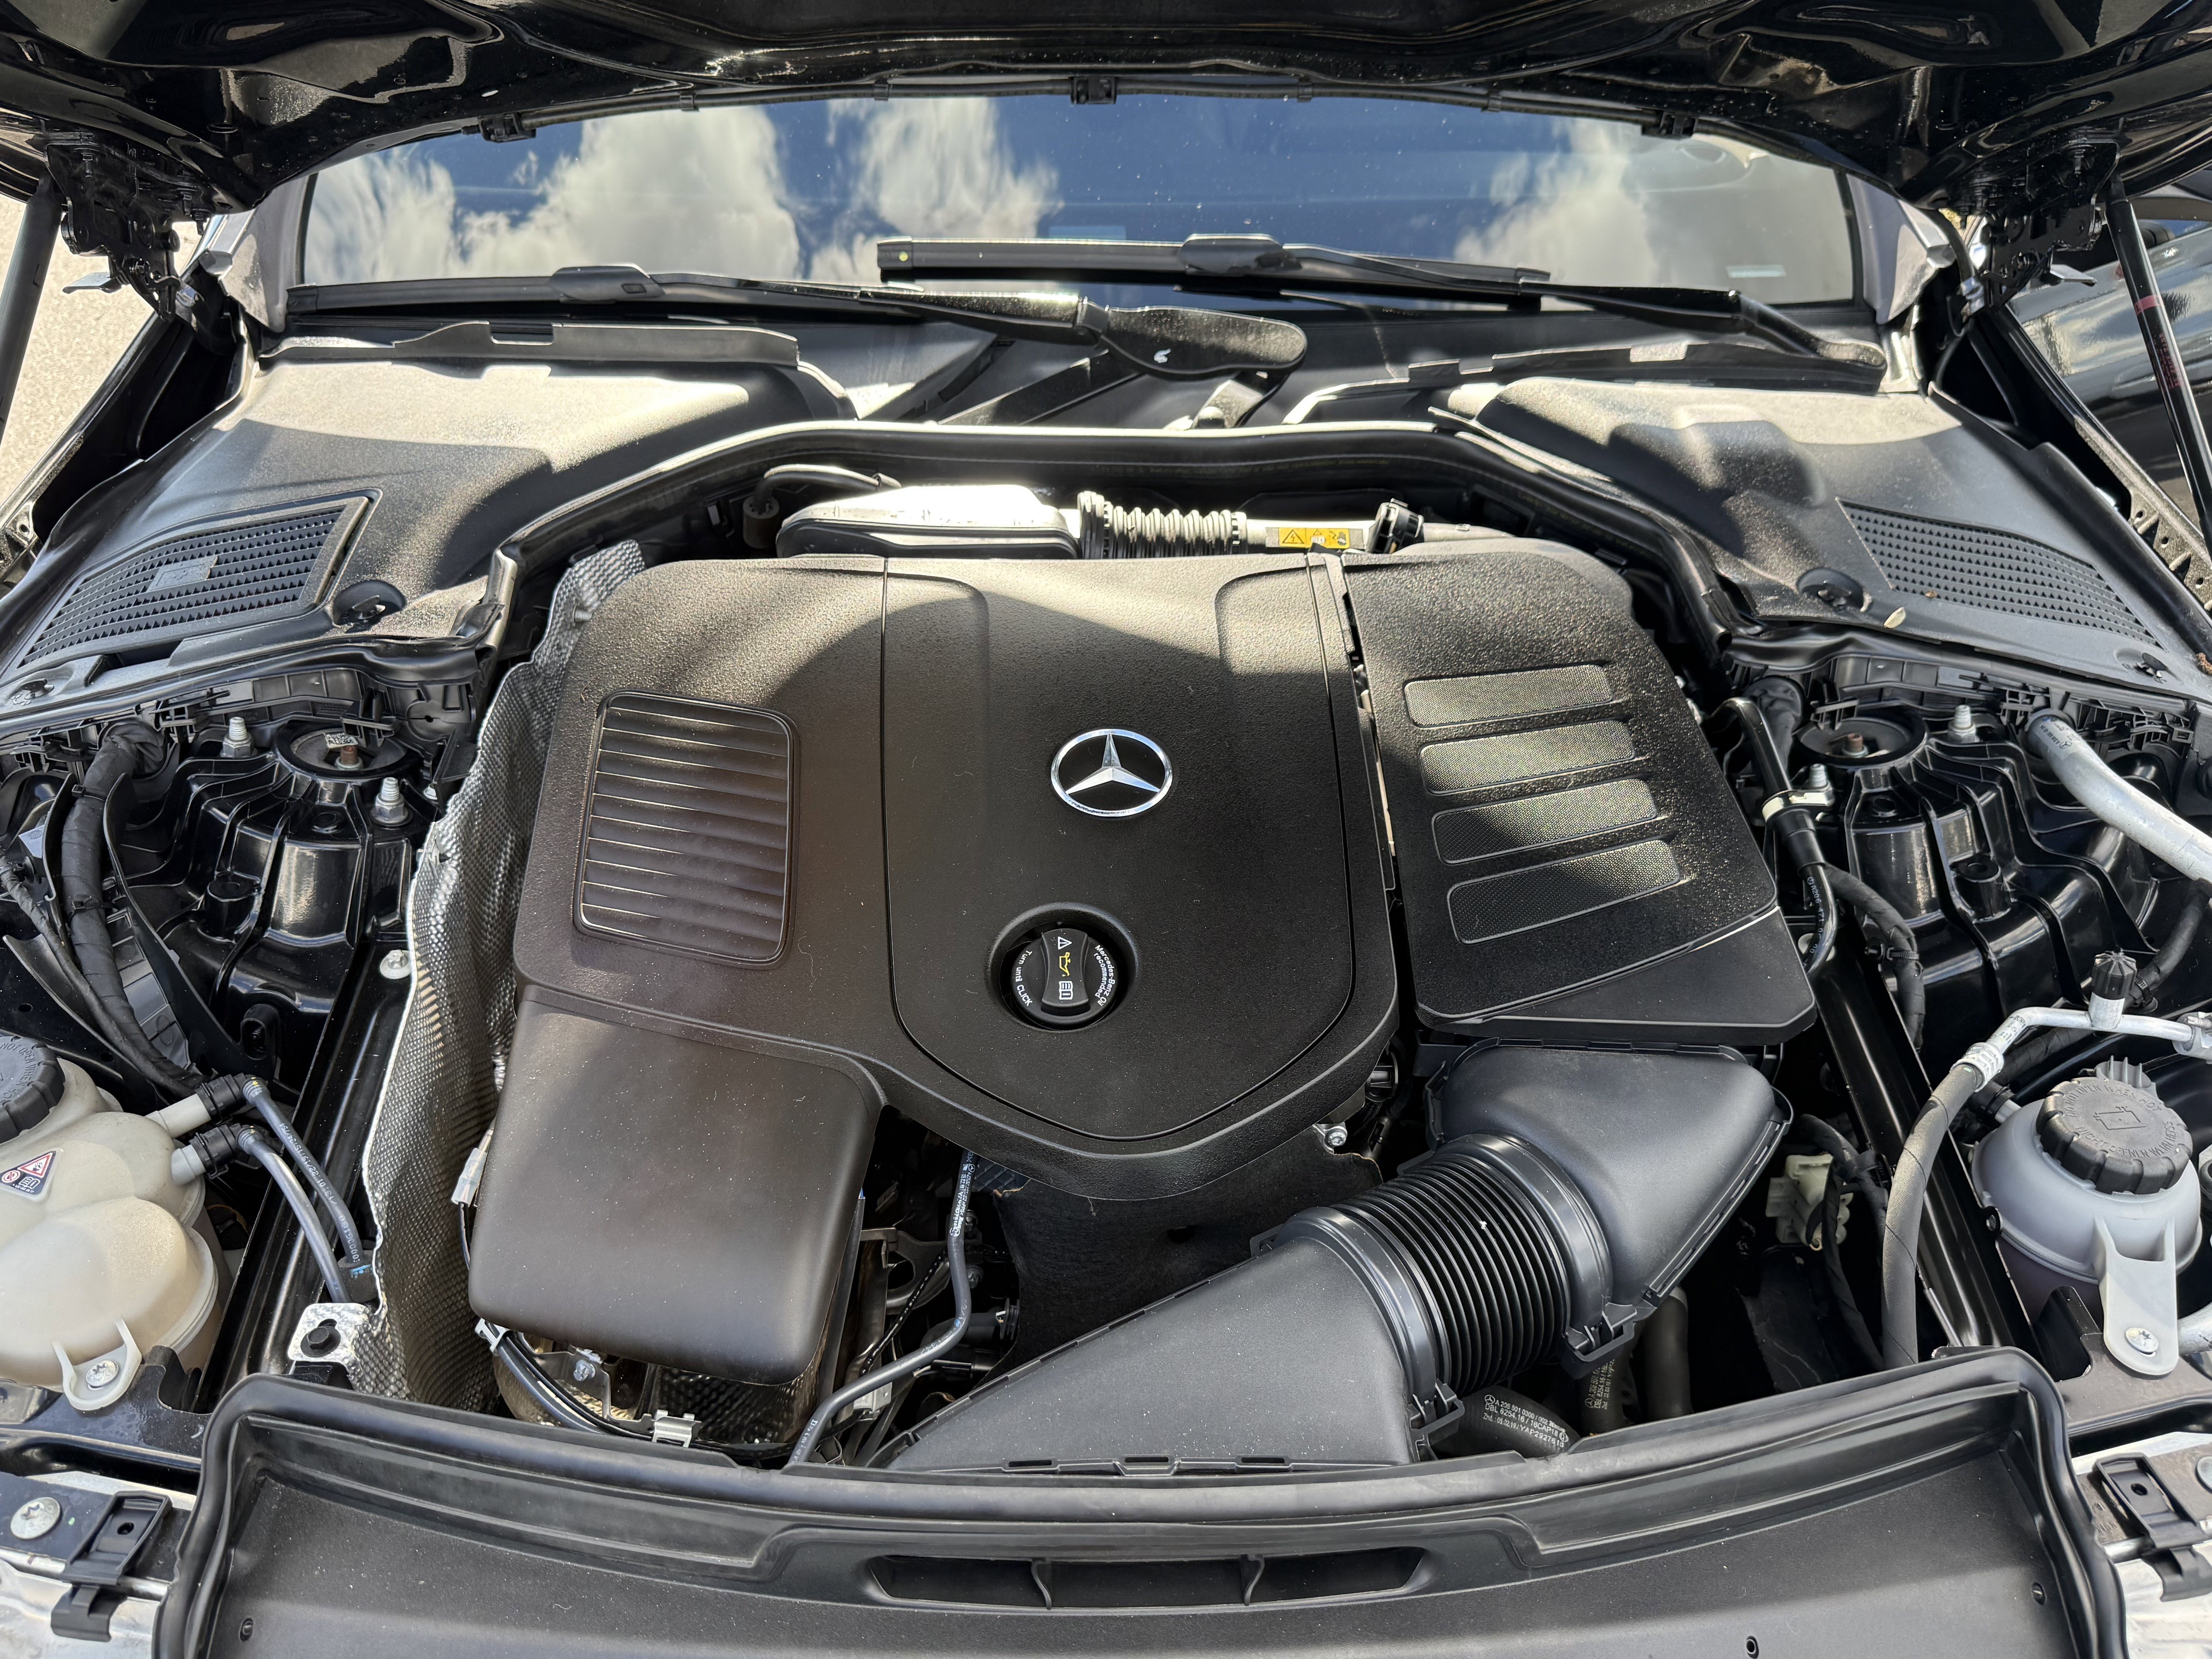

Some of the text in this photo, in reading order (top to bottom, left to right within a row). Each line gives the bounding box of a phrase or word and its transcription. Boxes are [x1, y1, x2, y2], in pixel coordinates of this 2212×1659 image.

[1810, 884, 1821, 903] A206
[1018, 950, 1033, 965] Turn
[1093, 952, 1107, 998] recommended
[1095, 945, 1116, 1007] Mercedes-Benz Oil
[1017, 984, 1034, 1007] CLICK
[2076, 1084, 2101, 1095] OPEN
[2103, 1084, 2137, 1099] WHEN
[2139, 1097, 2162, 1112] HOT
[2076, 1126, 2109, 1147] NICHT
[1485, 1403, 1498, 1413] DBL
[1511, 1405, 1521, 1413] 501
